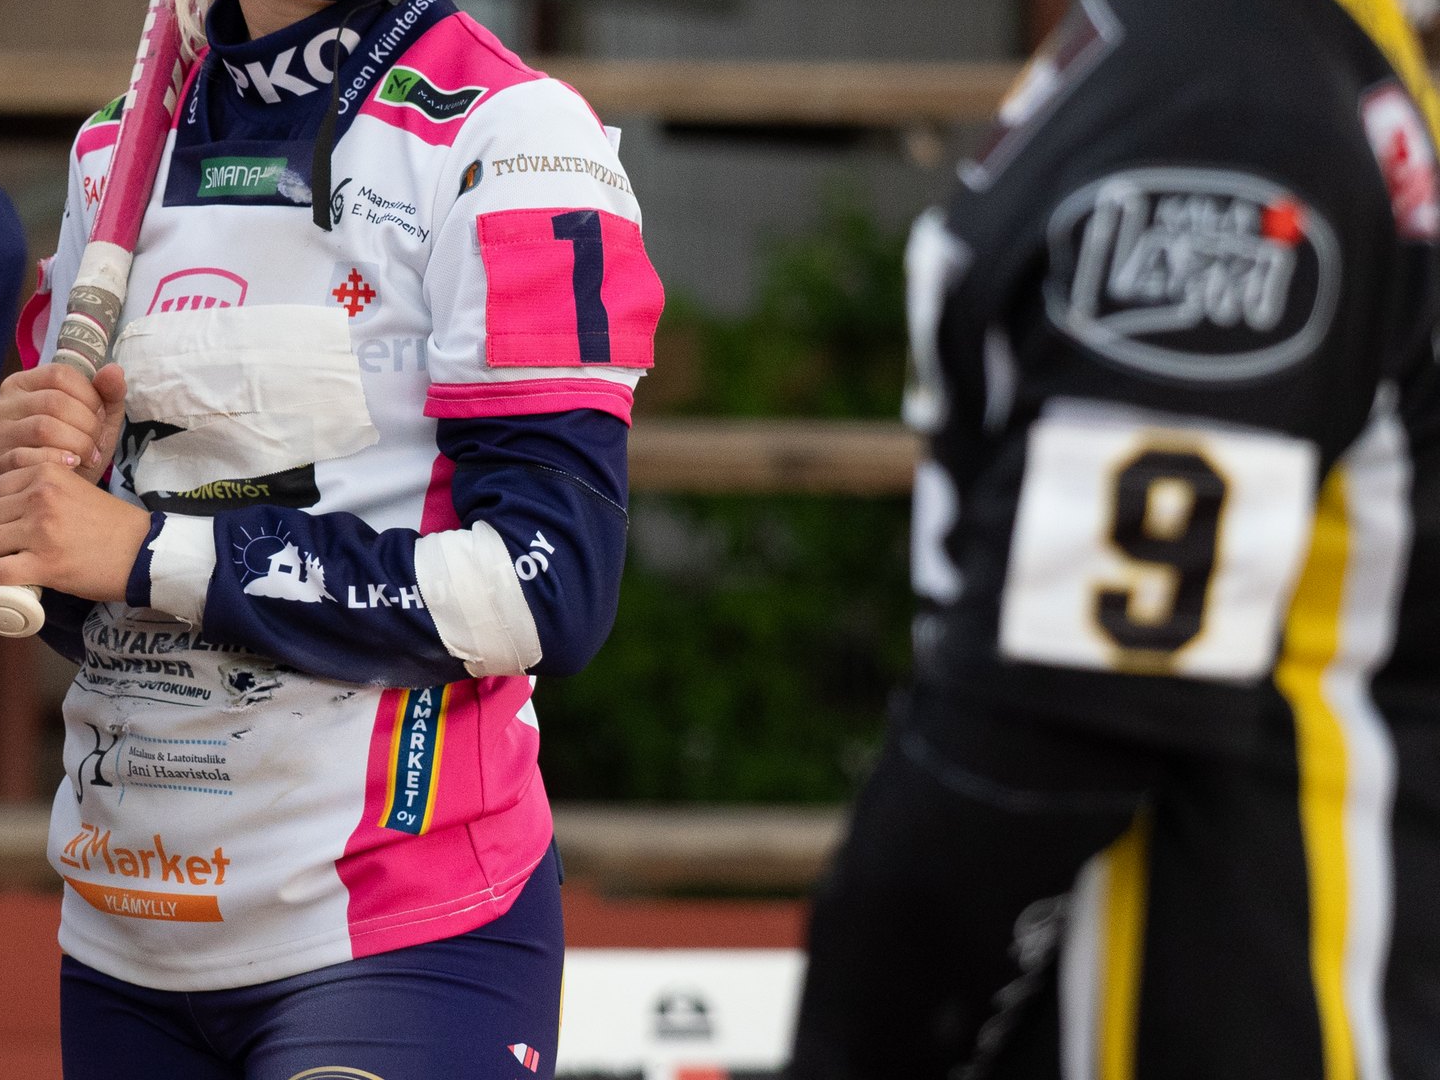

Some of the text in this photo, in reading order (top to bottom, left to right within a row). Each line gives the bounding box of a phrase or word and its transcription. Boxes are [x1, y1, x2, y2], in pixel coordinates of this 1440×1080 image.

[351, 203, 363, 216] E.
[357, 186, 417, 215] Maansiirto
[551, 209, 612, 363] 1
[1087, 430, 1230, 674] 9
[156, 751, 165, 761] &
[167, 751, 226, 765] Laatoitusliike
[405, 687, 433, 807] AMARKET
[127, 760, 231, 782] Jani Haavistola
[104, 894, 177, 917] YLÄMYLLY
